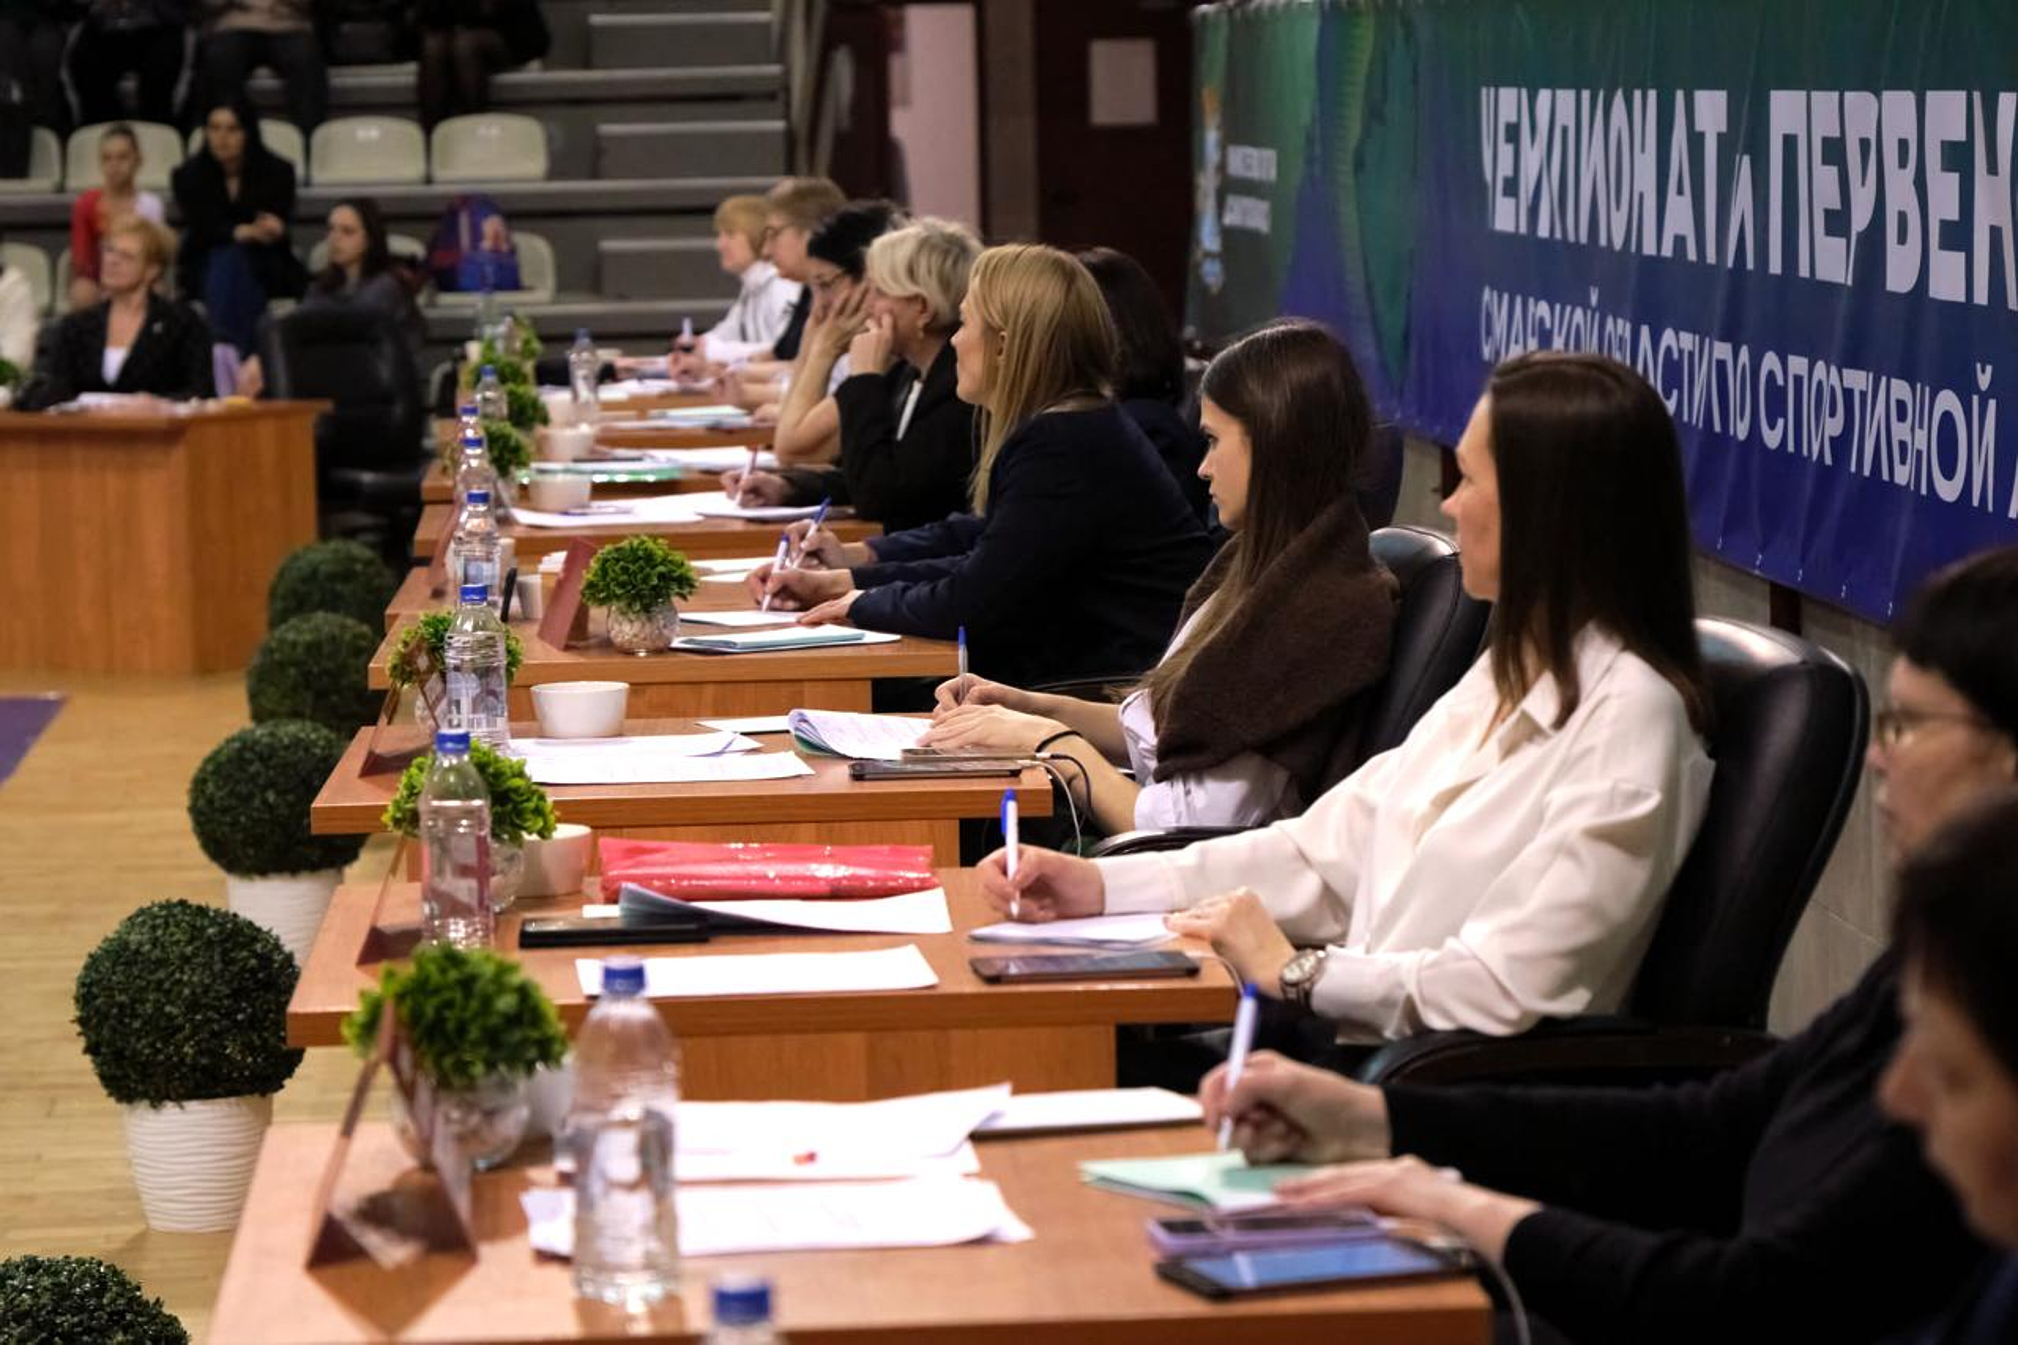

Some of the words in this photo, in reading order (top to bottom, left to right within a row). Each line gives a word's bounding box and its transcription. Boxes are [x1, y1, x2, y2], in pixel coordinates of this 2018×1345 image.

[1481, 86, 1727, 265] ЧЕМПИОНАТ
[1768, 89, 2018, 313] ПЕРВЕН
[1711, 339, 1751, 441] ПО
[1759, 350, 1997, 513] СПОРТИВНОЙ
